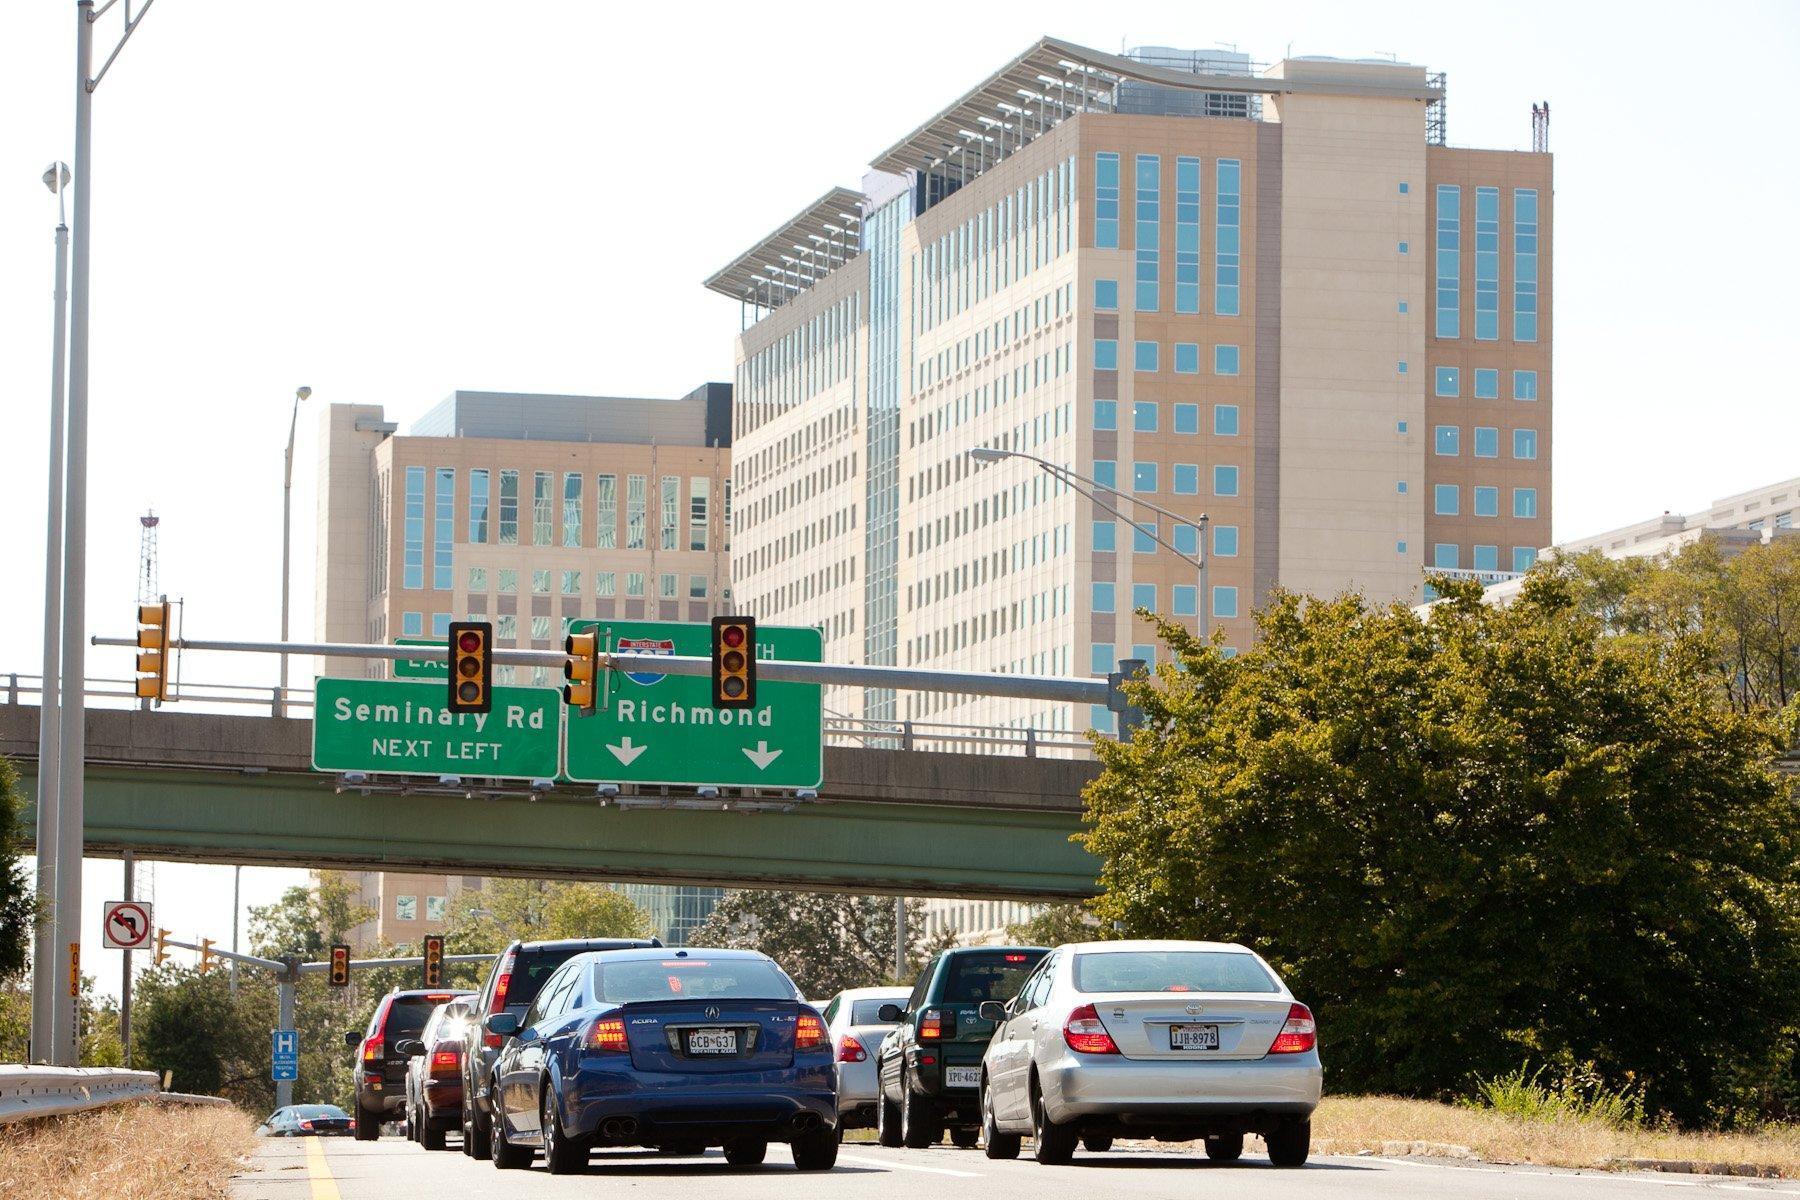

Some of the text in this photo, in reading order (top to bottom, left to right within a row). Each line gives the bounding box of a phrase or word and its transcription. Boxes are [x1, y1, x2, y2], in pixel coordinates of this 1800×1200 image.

[334, 697, 544, 733] Seminary Rd
[617, 699, 772, 727] Richmond
[372, 738, 502, 761] NEXT LEFT
[278, 1034, 293, 1052] H
[1173, 1032, 1216, 1044] JJH-8978
